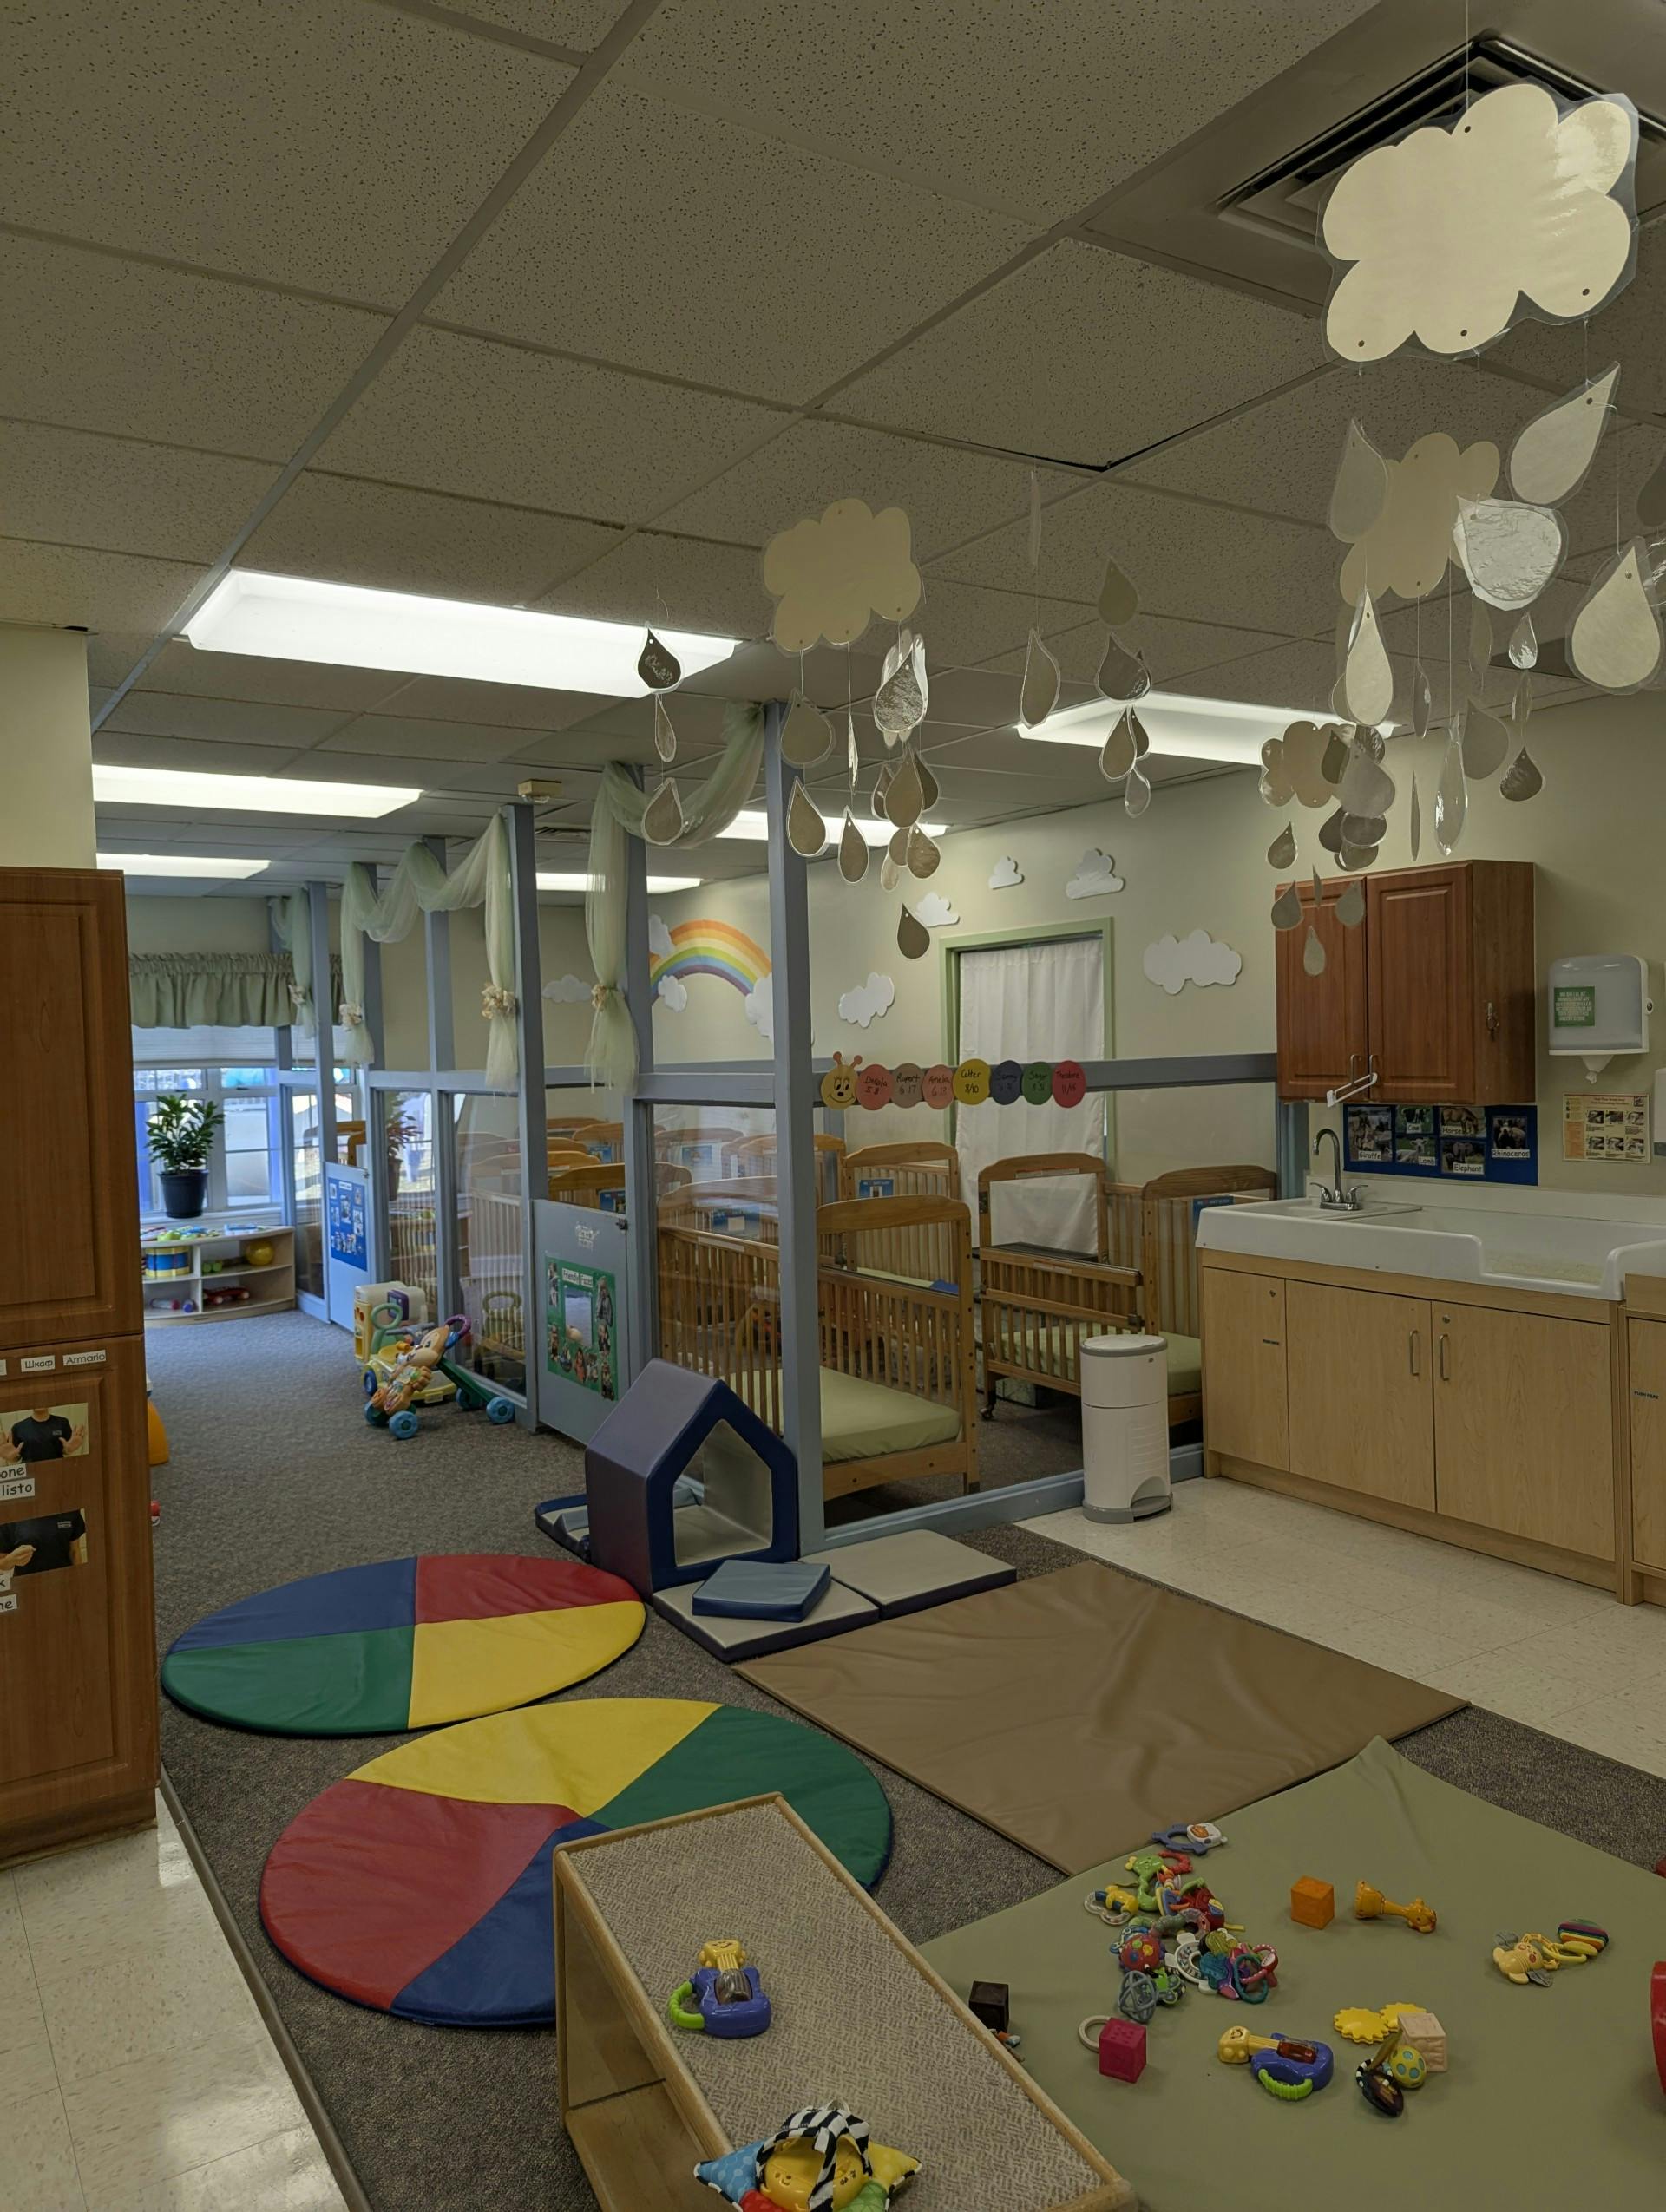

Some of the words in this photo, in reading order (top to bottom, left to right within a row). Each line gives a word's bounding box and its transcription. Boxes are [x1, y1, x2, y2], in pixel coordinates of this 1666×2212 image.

[1454, 1163, 1482, 1173] Elephant
[24, 1359, 53, 1369] Шкаф
[66, 1353, 105, 1365] Armario
[2, 1483, 33, 1496] listo
